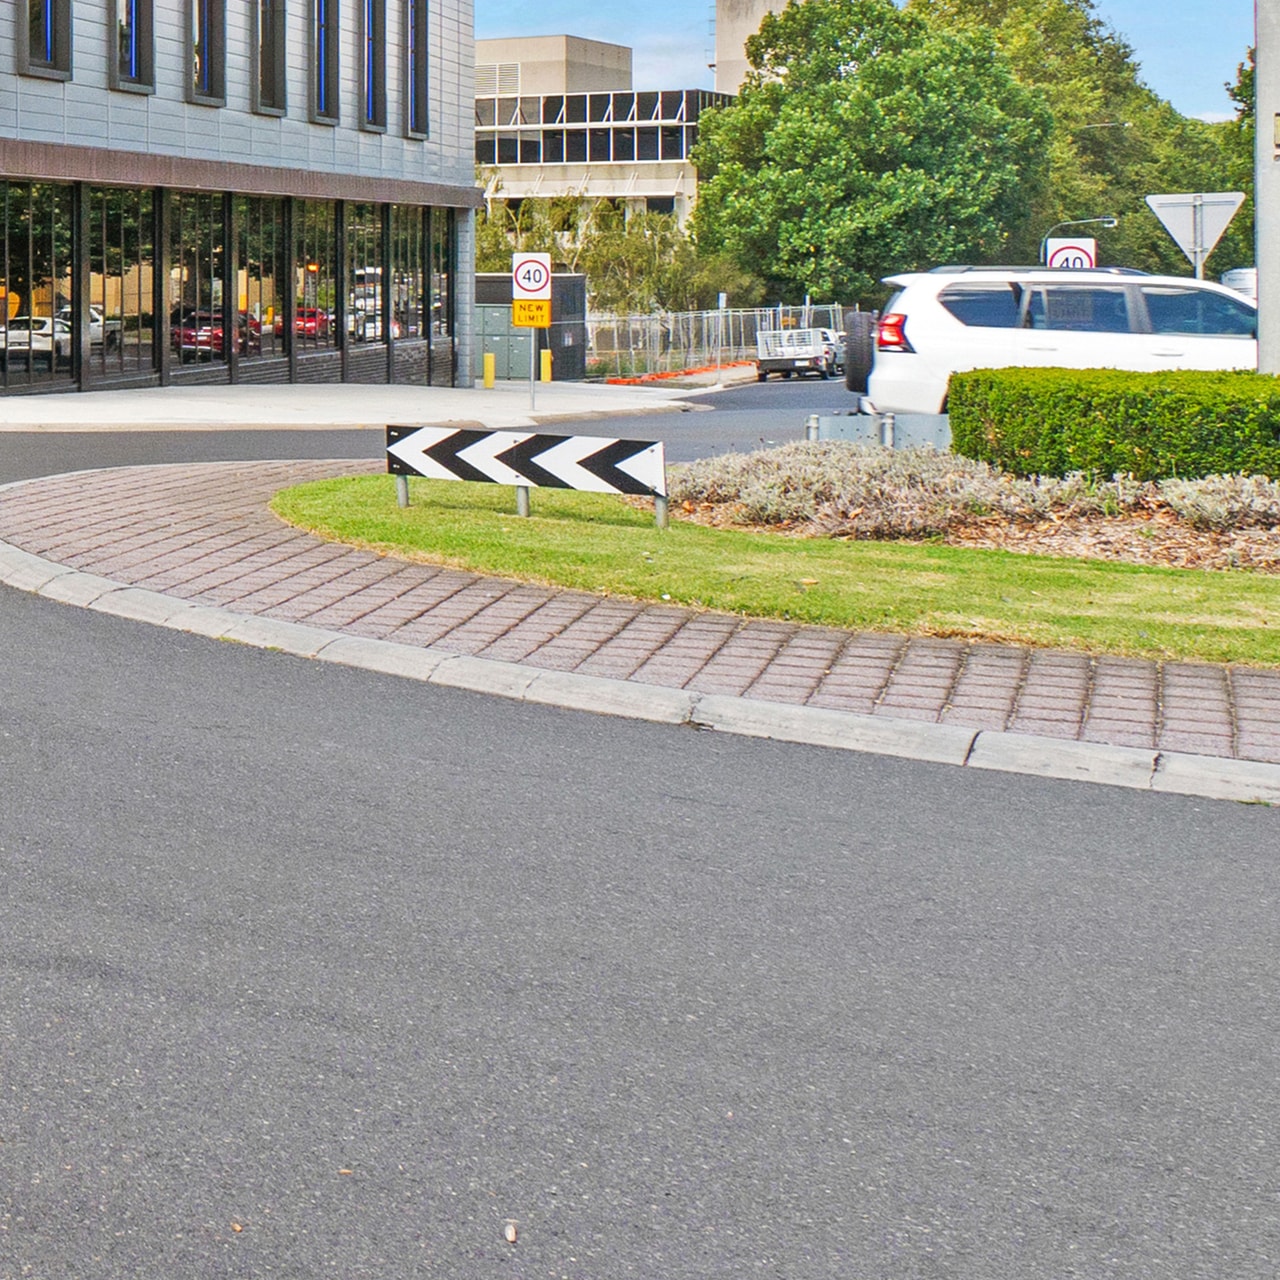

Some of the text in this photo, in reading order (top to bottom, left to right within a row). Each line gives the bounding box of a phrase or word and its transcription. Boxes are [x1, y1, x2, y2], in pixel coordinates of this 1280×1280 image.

[1059, 256, 1083, 268] 40
[522, 269, 542, 283] 40
[520, 304, 543, 312] NEW
[518, 314, 545, 323] LIMIT
